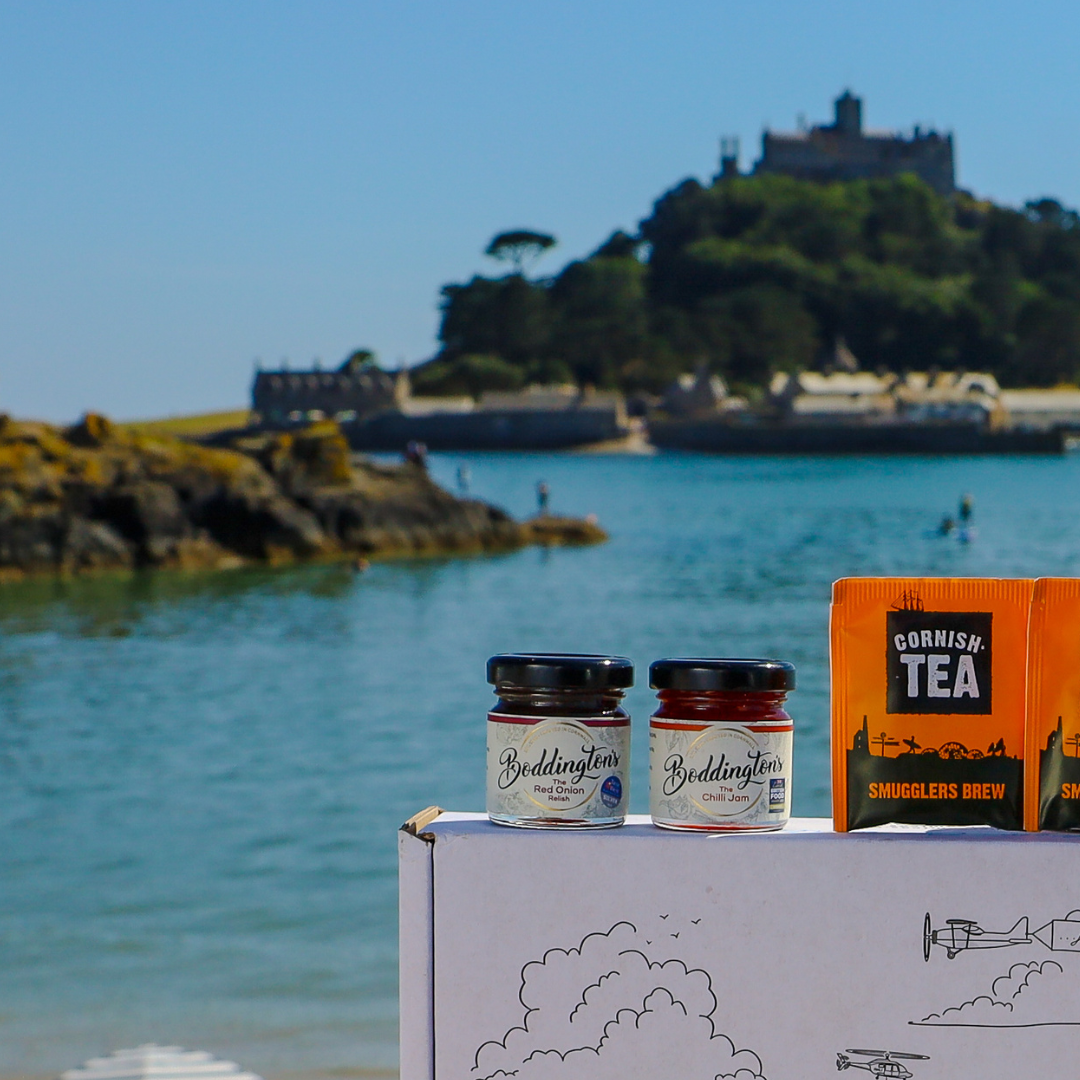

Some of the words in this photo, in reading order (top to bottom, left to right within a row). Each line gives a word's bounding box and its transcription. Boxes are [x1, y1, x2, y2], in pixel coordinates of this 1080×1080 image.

[900, 654, 980, 698] TEA
[498, 744, 620, 790] Boddington's
[662, 750, 784, 796] Boddington's
[534, 785, 553, 794] Red
[556, 786, 584, 794] Onion
[702, 793, 726, 802] Chilli
[728, 794, 750, 802] Jam
[868, 782, 958, 800] SMUGGLERS
[962, 782, 1006, 800] BREW
